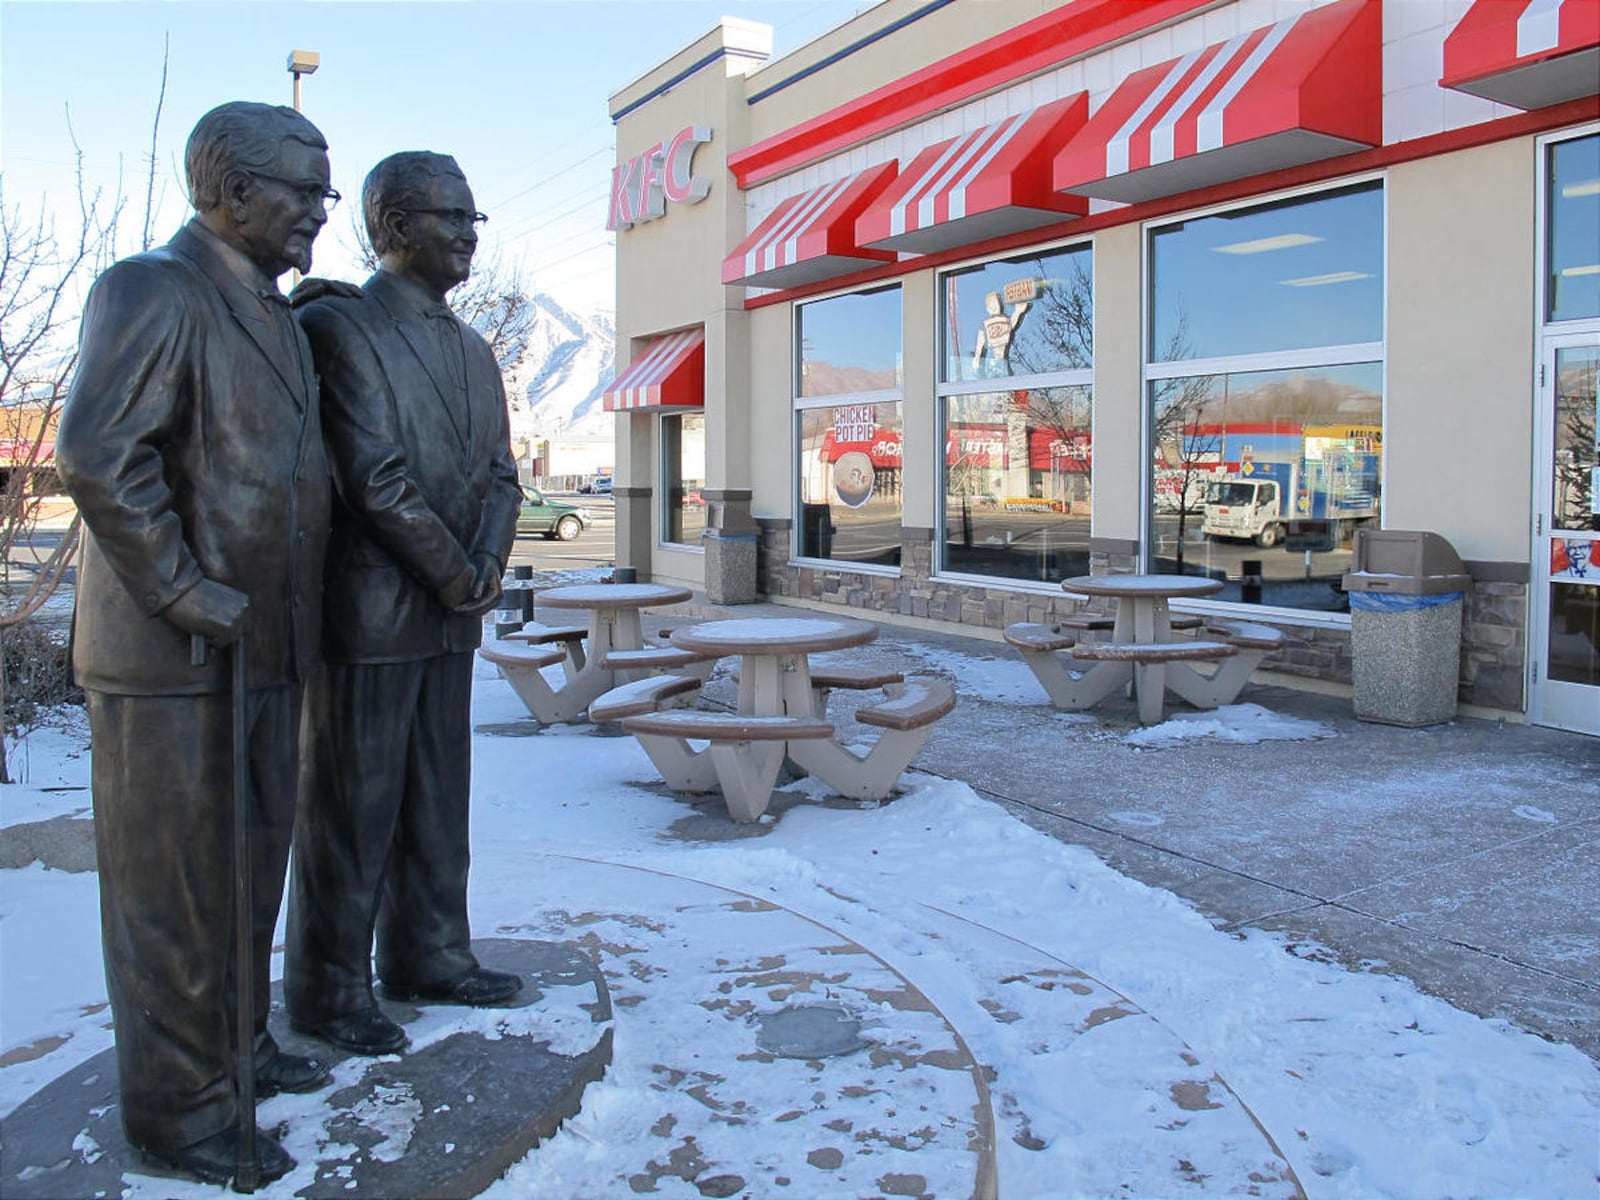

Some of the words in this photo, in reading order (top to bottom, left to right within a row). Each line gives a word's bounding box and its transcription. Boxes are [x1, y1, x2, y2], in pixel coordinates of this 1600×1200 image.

[606, 126, 712, 231] KFC
[833, 405, 876, 424] CHICKEN
[835, 425, 855, 441] POT
[856, 424, 875, 441] PIE
